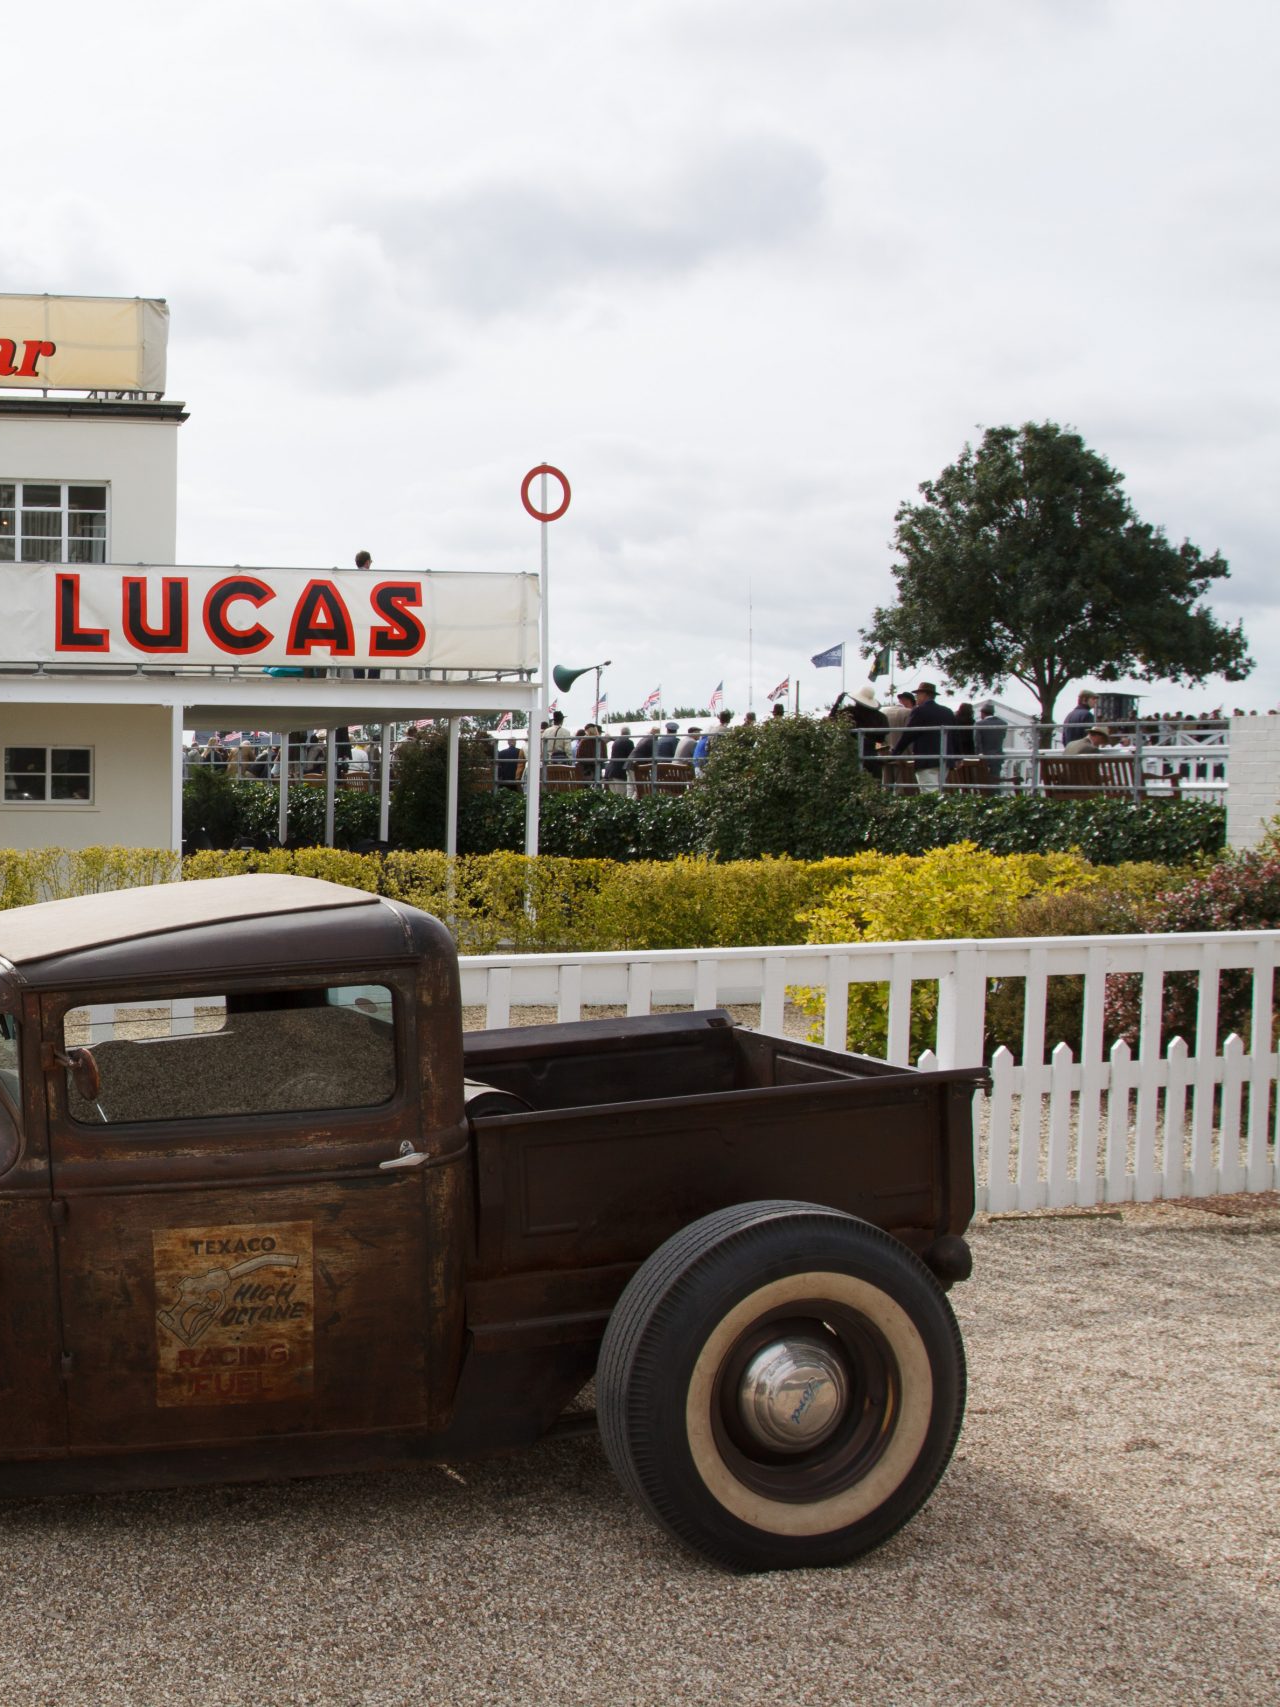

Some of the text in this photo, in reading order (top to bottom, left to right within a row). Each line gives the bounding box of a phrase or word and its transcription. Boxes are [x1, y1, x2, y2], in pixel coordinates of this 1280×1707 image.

[54, 573, 427, 658] LUCAS
[189, 1236, 277, 1256] TEXACO
[234, 1283, 296, 1302] HIGH
[222, 1302, 305, 1326] OCTANE
[177, 1344, 289, 1368] RACING
[192, 1371, 274, 1395] FUEL
[791, 1376, 821, 1425] Ford
